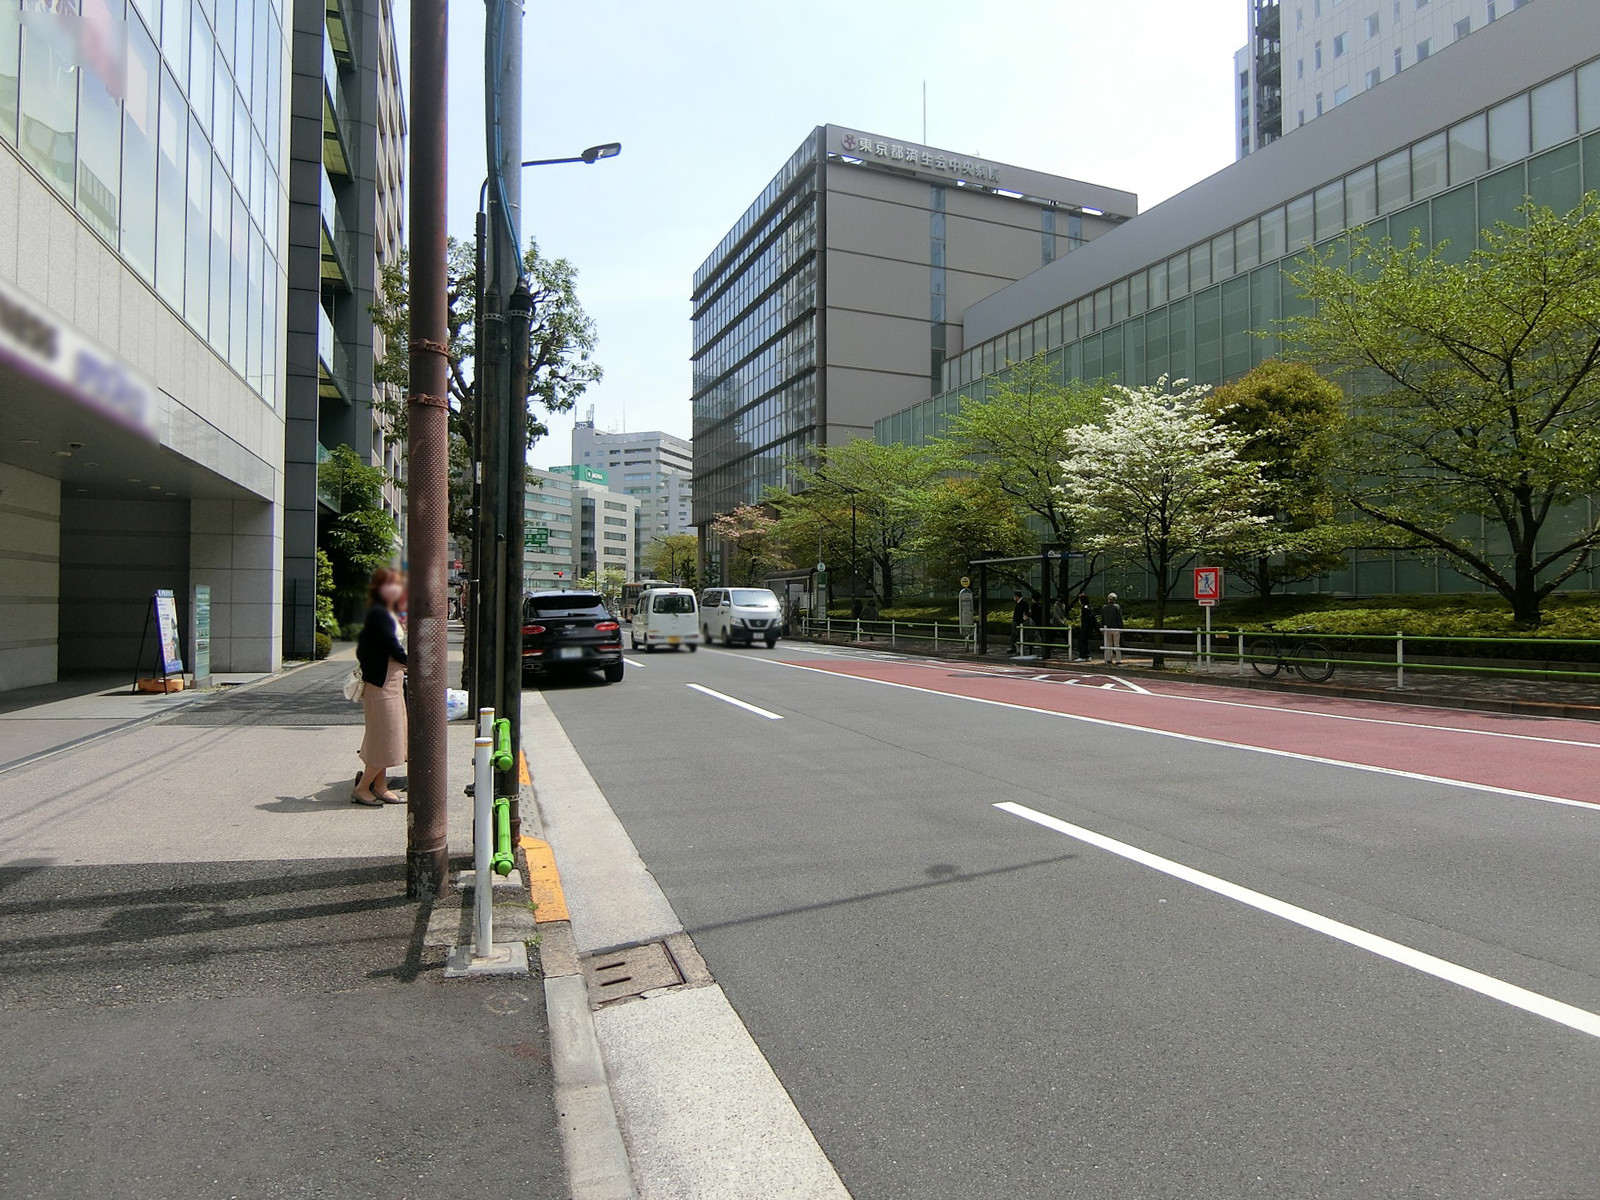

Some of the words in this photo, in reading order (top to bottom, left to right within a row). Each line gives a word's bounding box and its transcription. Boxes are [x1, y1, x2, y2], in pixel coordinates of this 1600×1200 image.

[858, 137, 999, 183] 東京都済生会中央病院
